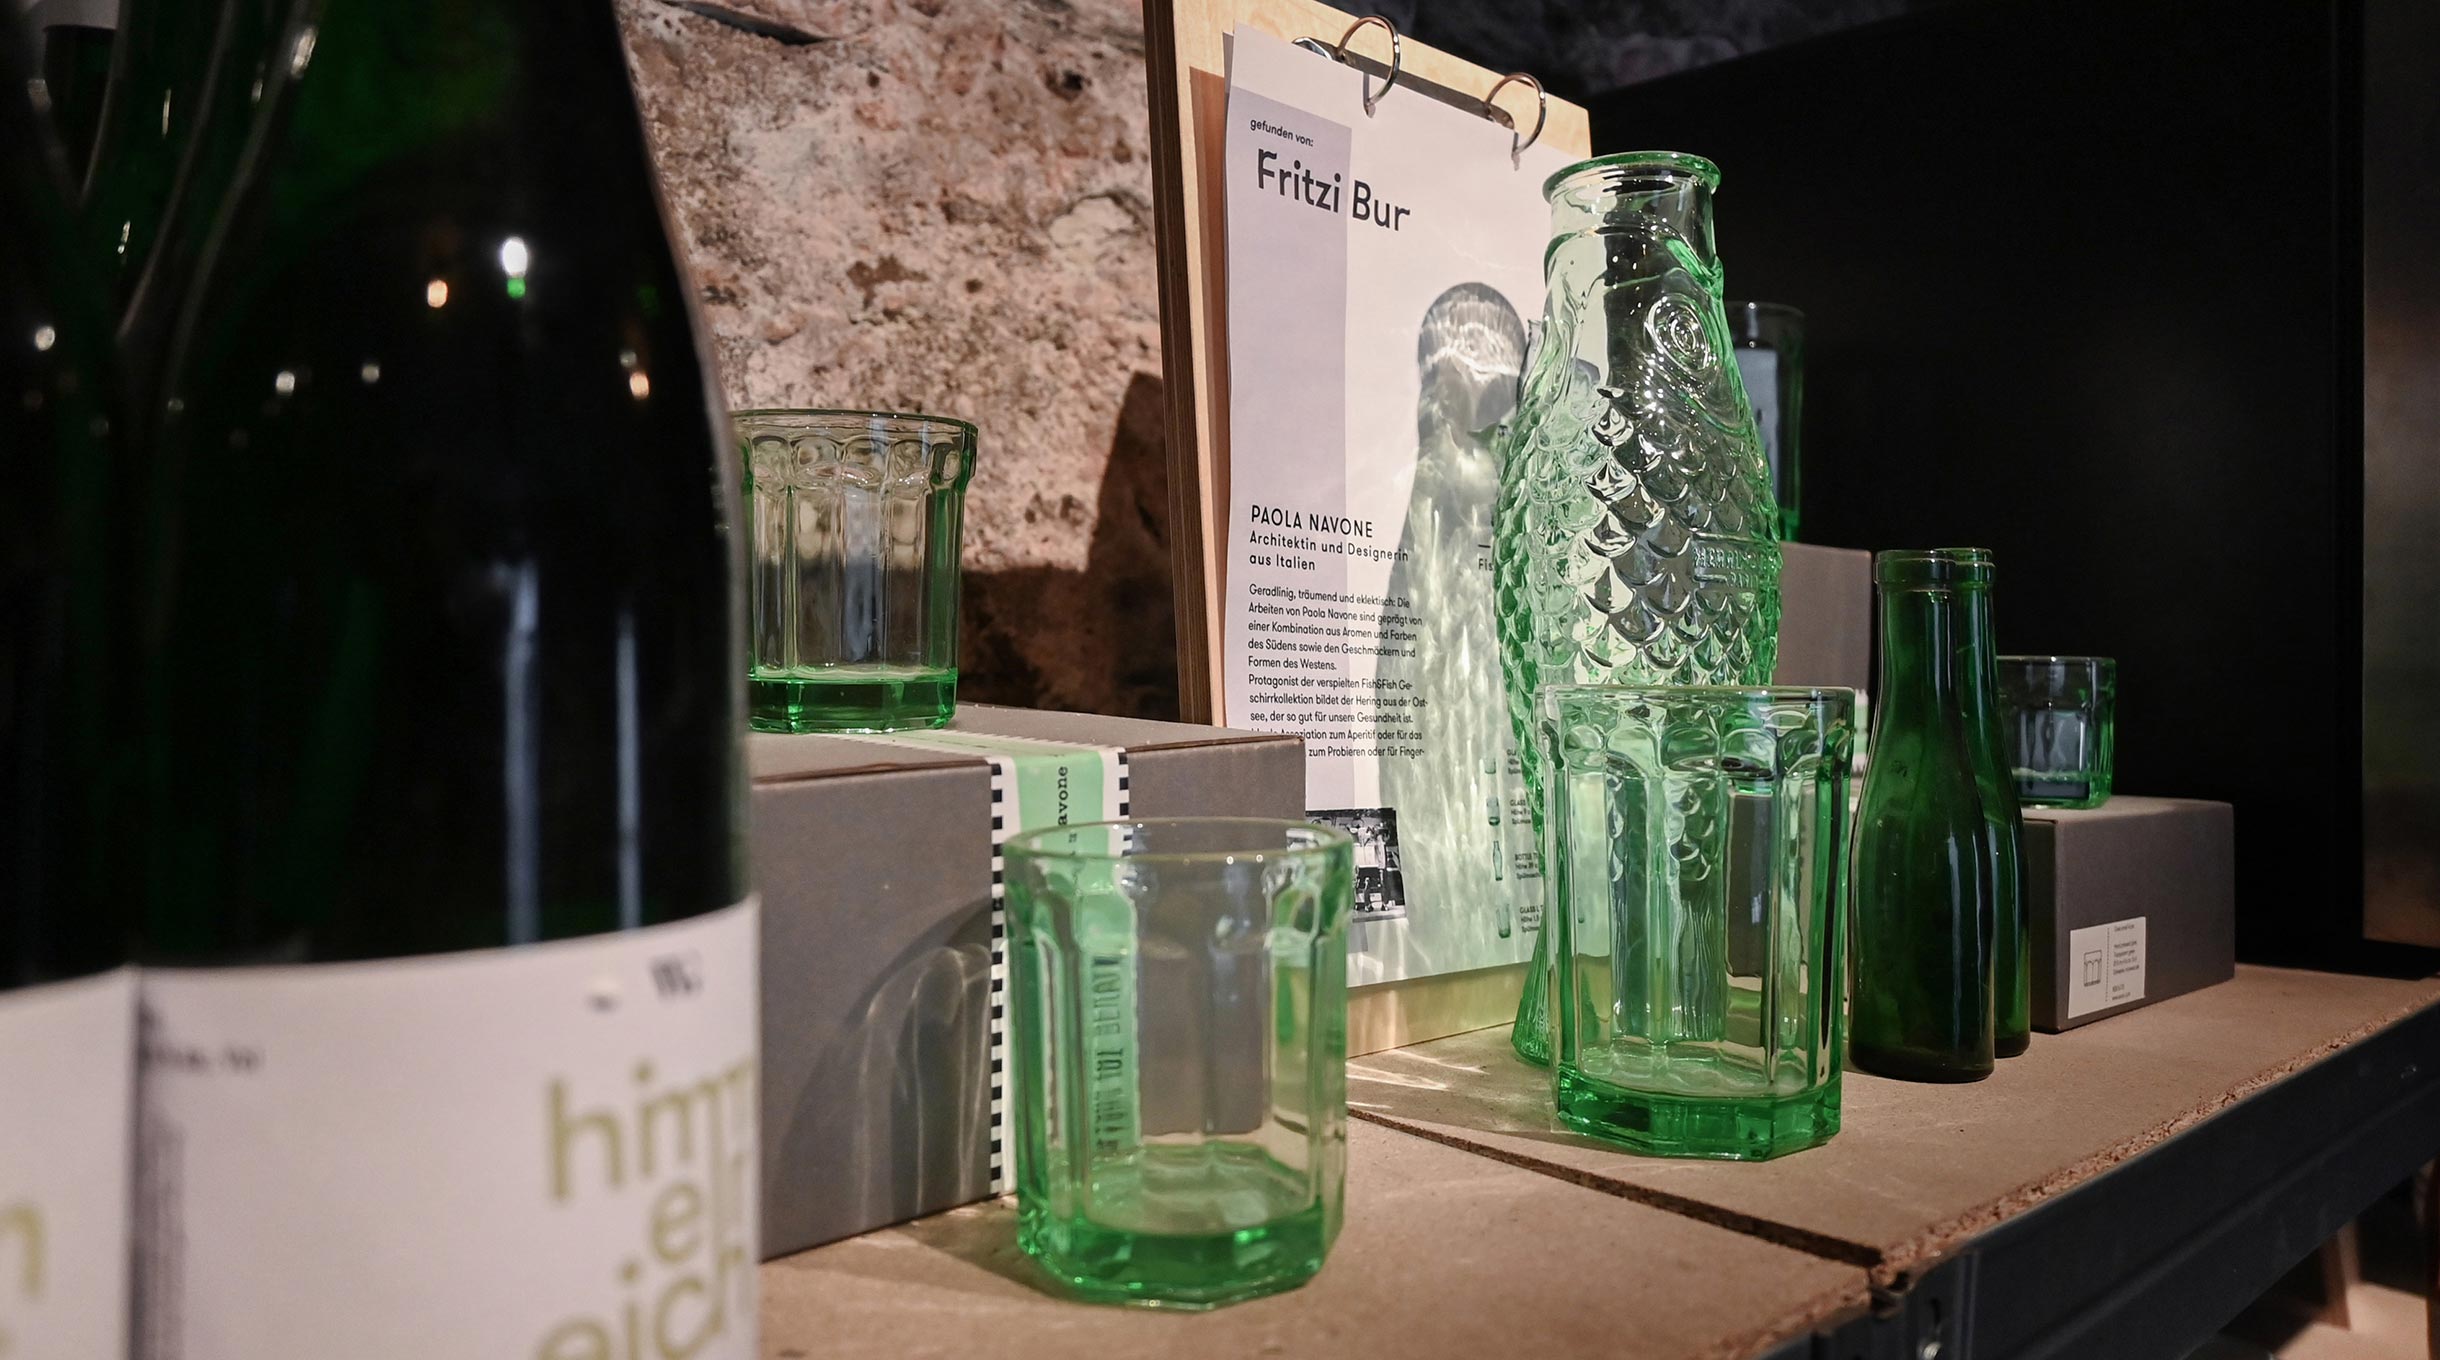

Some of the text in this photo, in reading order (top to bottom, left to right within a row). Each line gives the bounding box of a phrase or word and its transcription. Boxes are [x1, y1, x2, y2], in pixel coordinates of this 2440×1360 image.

[1250, 118, 1314, 147] gefunden von:
[1257, 148, 1411, 232] Fritzi Bur
[1251, 505, 1373, 538] PAOLA NAVONE
[1249, 530, 1409, 562] Architektin und Designerin
[1249, 553, 1316, 571] aus Italien
[1249, 583, 1410, 609] Geradlinig, träumend und eklektisch: Die
[1248, 601, 1423, 628] Arbeiten von Paola Navone sind geprägt von
[1248, 620, 1417, 641] einer Kombination aus Aromen und Farben
[1248, 637, 1416, 658] des Südens sowie den Geschmäckern und
[1248, 655, 1337, 671] Formen des Westens.
[1248, 673, 1299, 689] Protagonist
[1300, 676, 1315, 687] der
[1316, 677, 1360, 691] verspielten
[1398, 679, 1413, 690] Ge-
[1249, 692, 1428, 710] schirrkollektion bildet der Hering aus der Ost-
[1250, 712, 1268, 723] see,
[1270, 710, 1285, 722] der
[1286, 713, 1297, 722] so
[1298, 712, 1313, 725] gut
[1314, 710, 1327, 722] für
[1328, 713, 1355, 723] unsere
[1356, 711, 1402, 723] Gesundheit
[1329, 731, 1346, 740] zum
[1347, 729, 1376, 742] Aperitif
[1377, 729, 1395, 740] oder
[1396, 729, 1408, 740] für
[1408, 730, 1423, 740] das
[1308, 745, 1425, 760] zum Probieren oder für Finger-
[1058, 766, 1069, 826] avone
